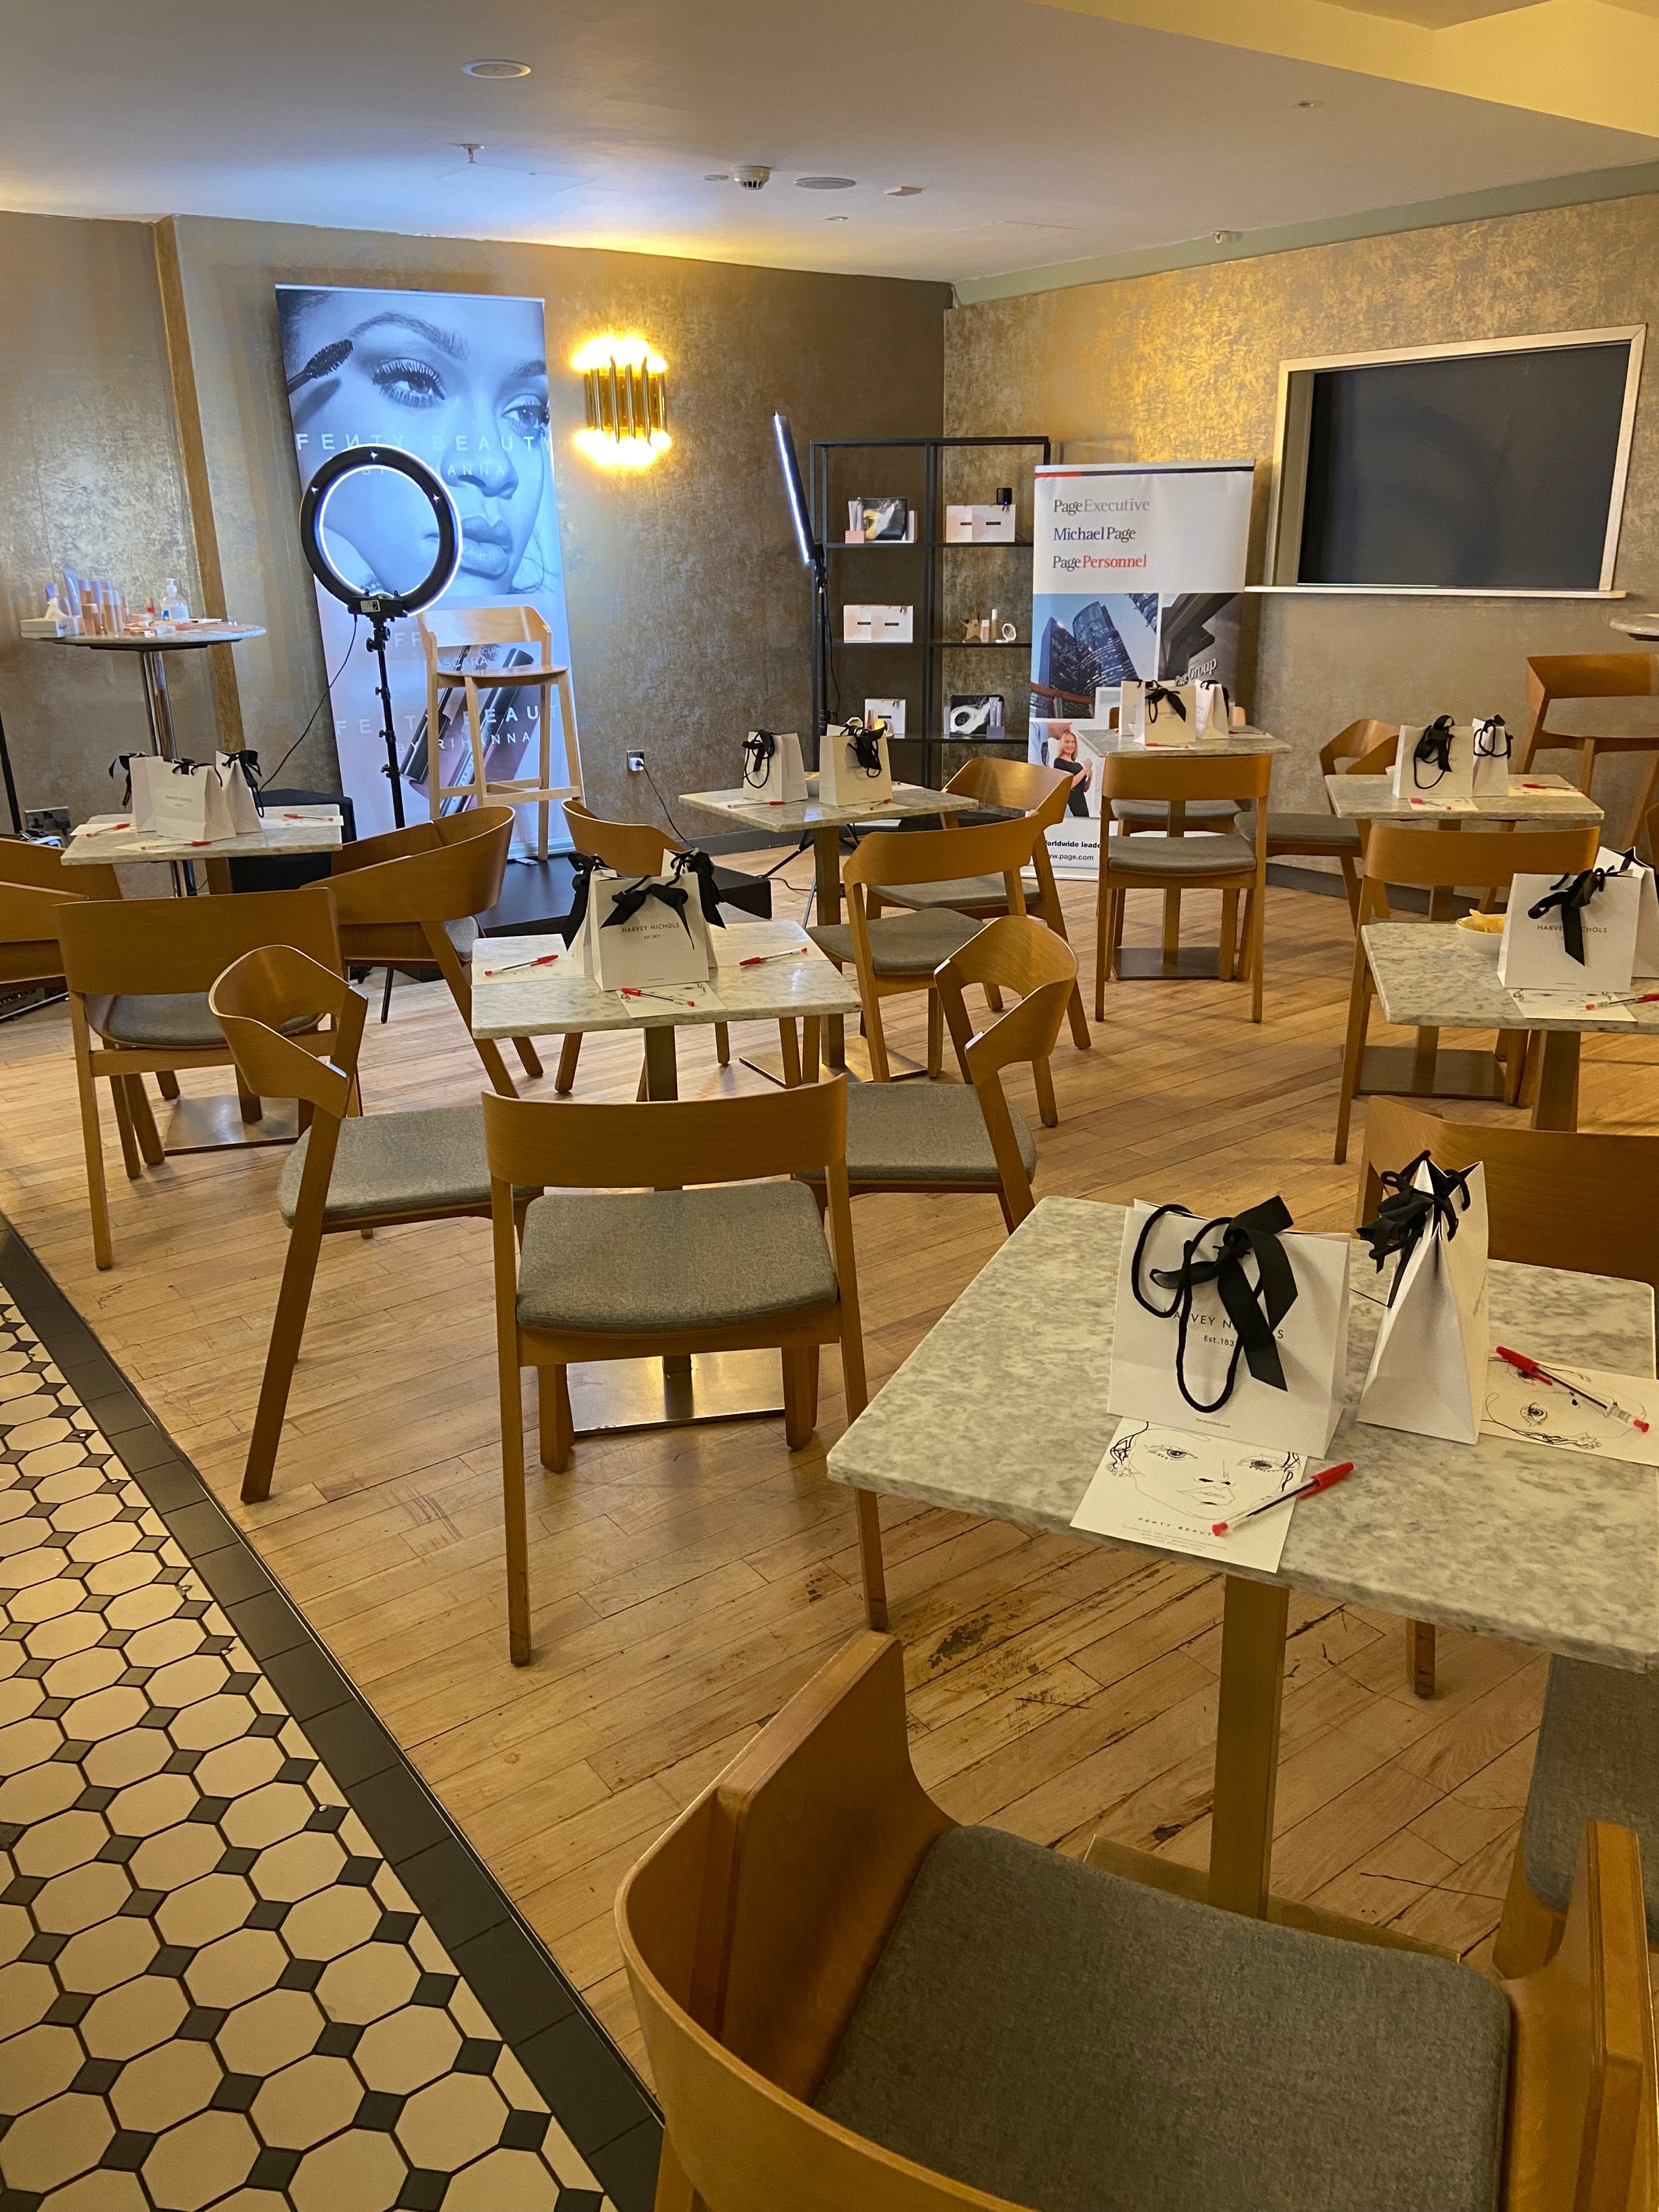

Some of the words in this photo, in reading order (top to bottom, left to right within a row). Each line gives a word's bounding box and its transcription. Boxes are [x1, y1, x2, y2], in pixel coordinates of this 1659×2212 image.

[1053, 499, 1083, 516] Page
[1084, 498, 1150, 512] Executive
[1054, 527, 1105, 541] Michael
[1106, 527, 1136, 543] Page
[1052, 556, 1081, 571] Page
[1082, 554, 1147, 568] Personnel
[438, 731, 531, 750] RIHNNA
[651, 922, 680, 930] NICHOLS
